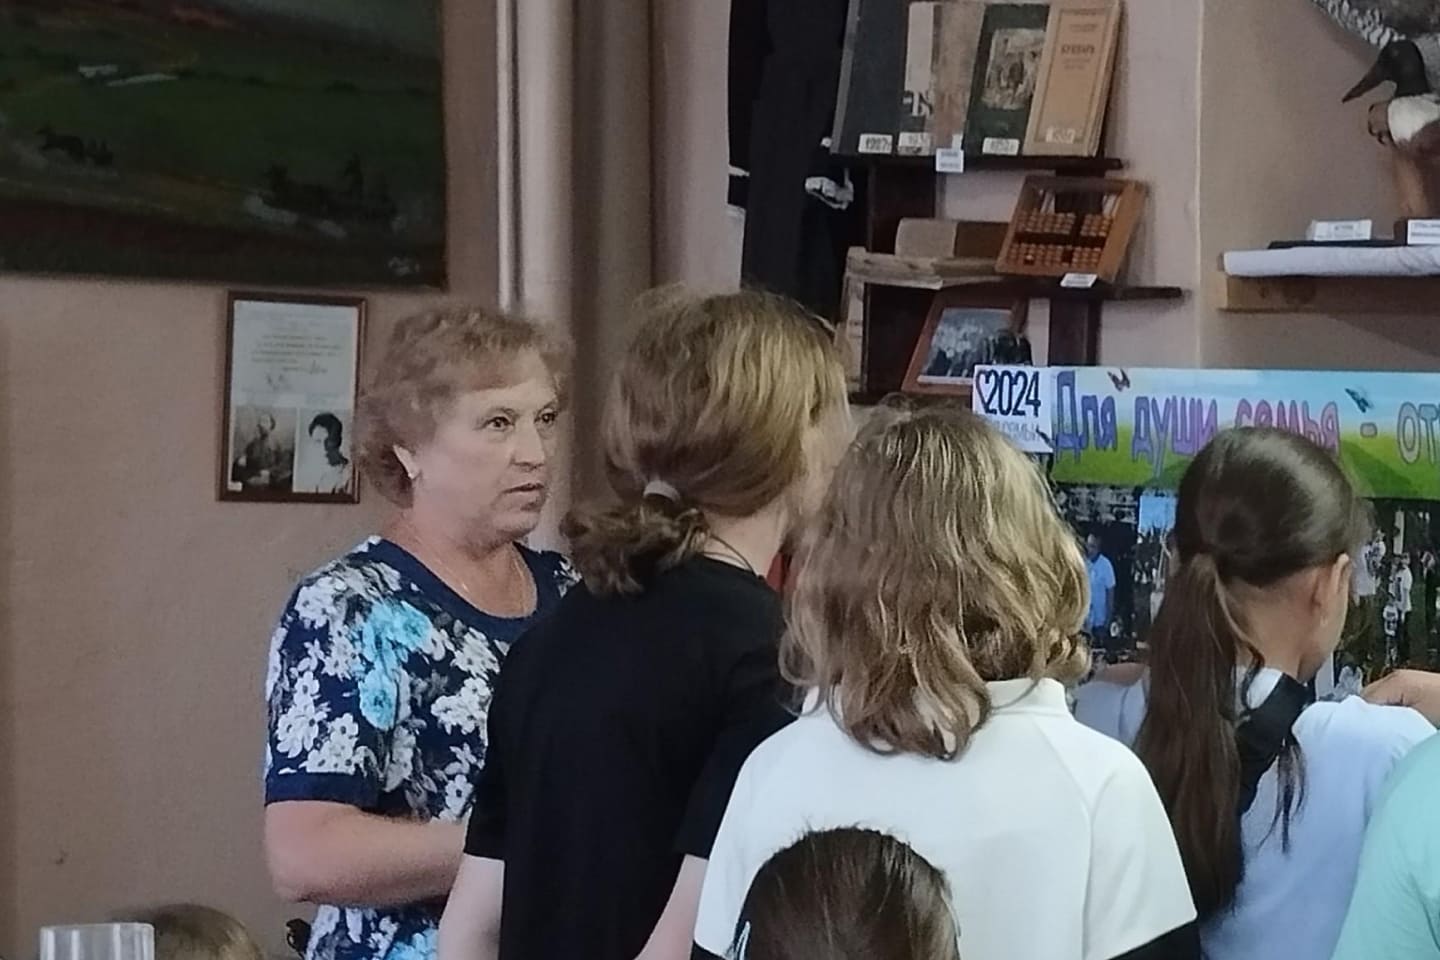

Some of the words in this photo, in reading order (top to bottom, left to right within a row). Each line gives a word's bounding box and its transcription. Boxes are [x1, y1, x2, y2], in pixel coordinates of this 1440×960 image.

[983, 369, 1041, 417] 2024
[1055, 370, 1118, 464] Для
[1131, 395, 1218, 479] души
